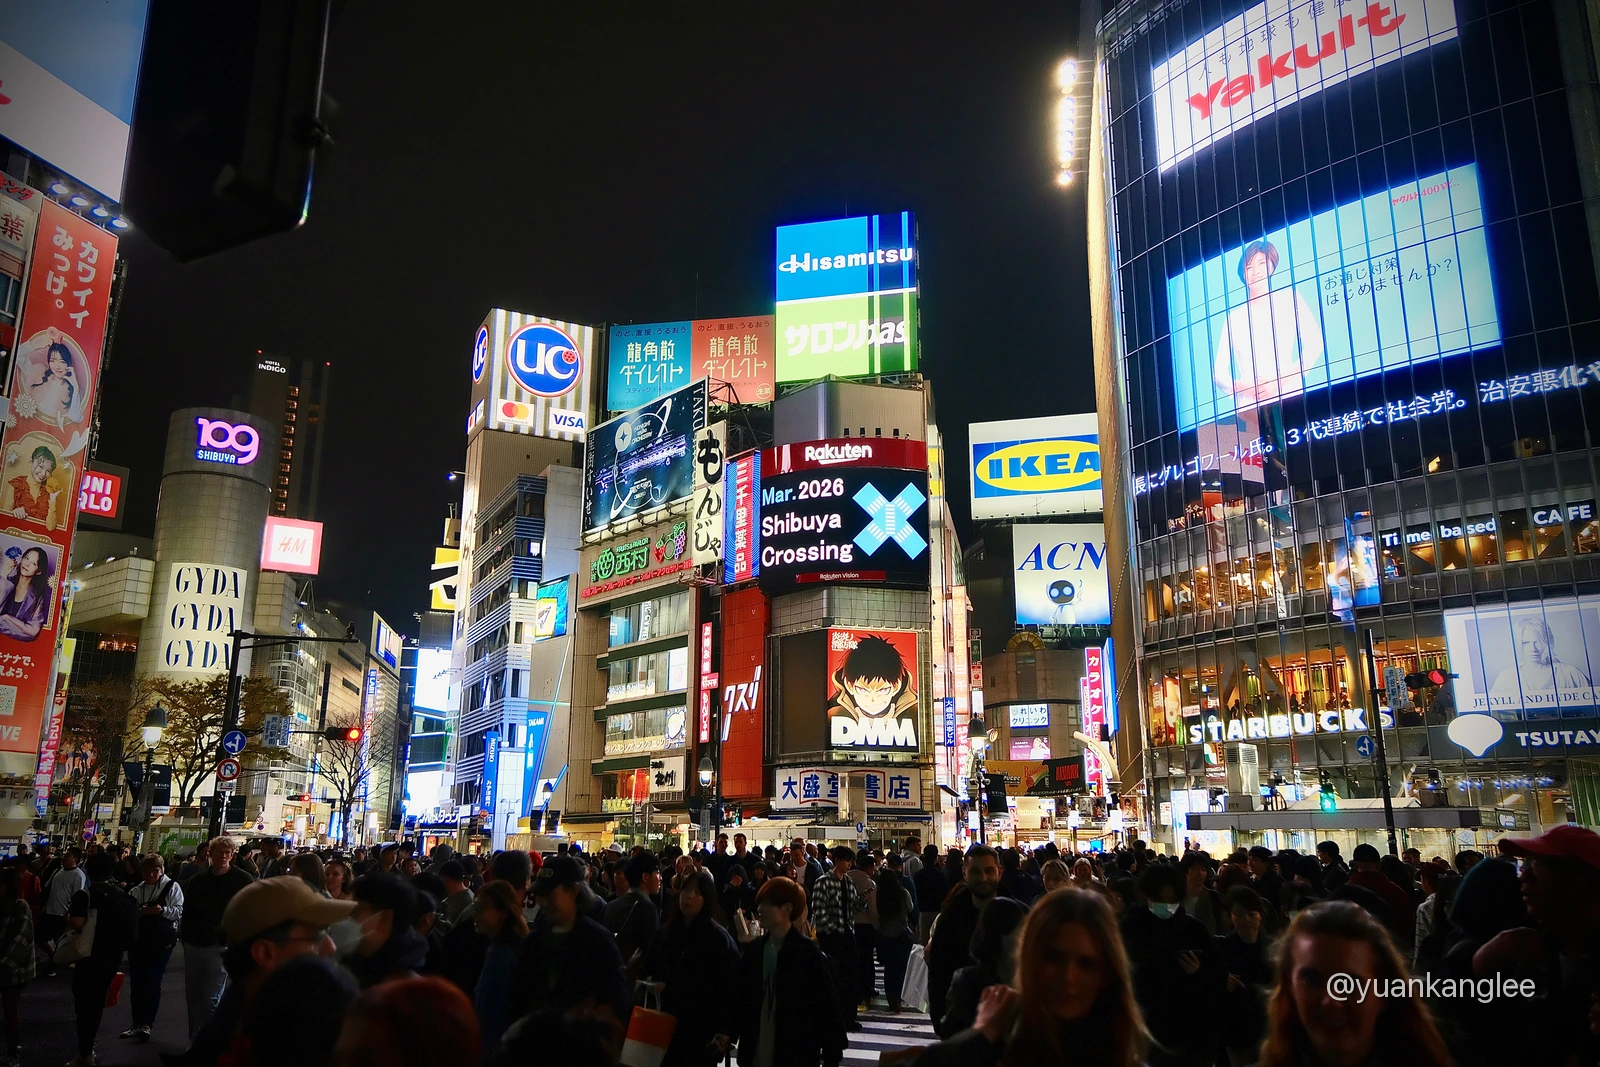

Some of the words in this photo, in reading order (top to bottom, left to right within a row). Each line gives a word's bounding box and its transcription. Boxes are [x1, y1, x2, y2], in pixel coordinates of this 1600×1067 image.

[1185, 2, 1406, 121] Yakult
[46, 225, 75, 309] みつけ。
[778, 247, 913, 274] Hisamitsu
[1325, 257, 1400, 290] お通じ対策
[69, 240, 99, 329] カワイイ
[615, 326, 687, 337] のど、直接、うるおう
[698, 321, 770, 332] のど、直接、うるおう
[516, 338, 575, 380] UC
[627, 339, 676, 363] 龍角散
[709, 334, 759, 358] 龍角散
[258, 363, 286, 374] INDIGO
[619, 363, 684, 386] ダイレクト
[702, 358, 768, 379] ダイレクト
[553, 413, 584, 429] VISA
[197, 418, 260, 465] 109
[805, 443, 873, 463] Rakuten
[198, 450, 236, 464] SHIBUYA
[989, 450, 1101, 480] IKEA
[694, 429, 723, 557] もんじゃ
[734, 462, 748, 573] 三千里薬品
[762, 512, 842, 538] Shibuya
[1440, 518, 1497, 539] based
[1533, 505, 1592, 525] CAFE
[278, 536, 307, 554] H&M
[762, 540, 853, 567] Crossing
[1017, 542, 1107, 571] ACN
[615, 546, 648, 575] 西村
[175, 566, 240, 599] GYDA
[820, 572, 842, 580] Rakuten
[170, 602, 235, 634] GYDA
[165, 639, 231, 671] GYDA
[1088, 656, 1102, 715] カラオケ
[528, 718, 545, 727] TAKAMI
[1012, 717, 1047, 725] クリニック
[1020, 707, 1046, 715] れいわ
[831, 716, 917, 747] DMM
[1190, 707, 1395, 743] STARBUCKS
